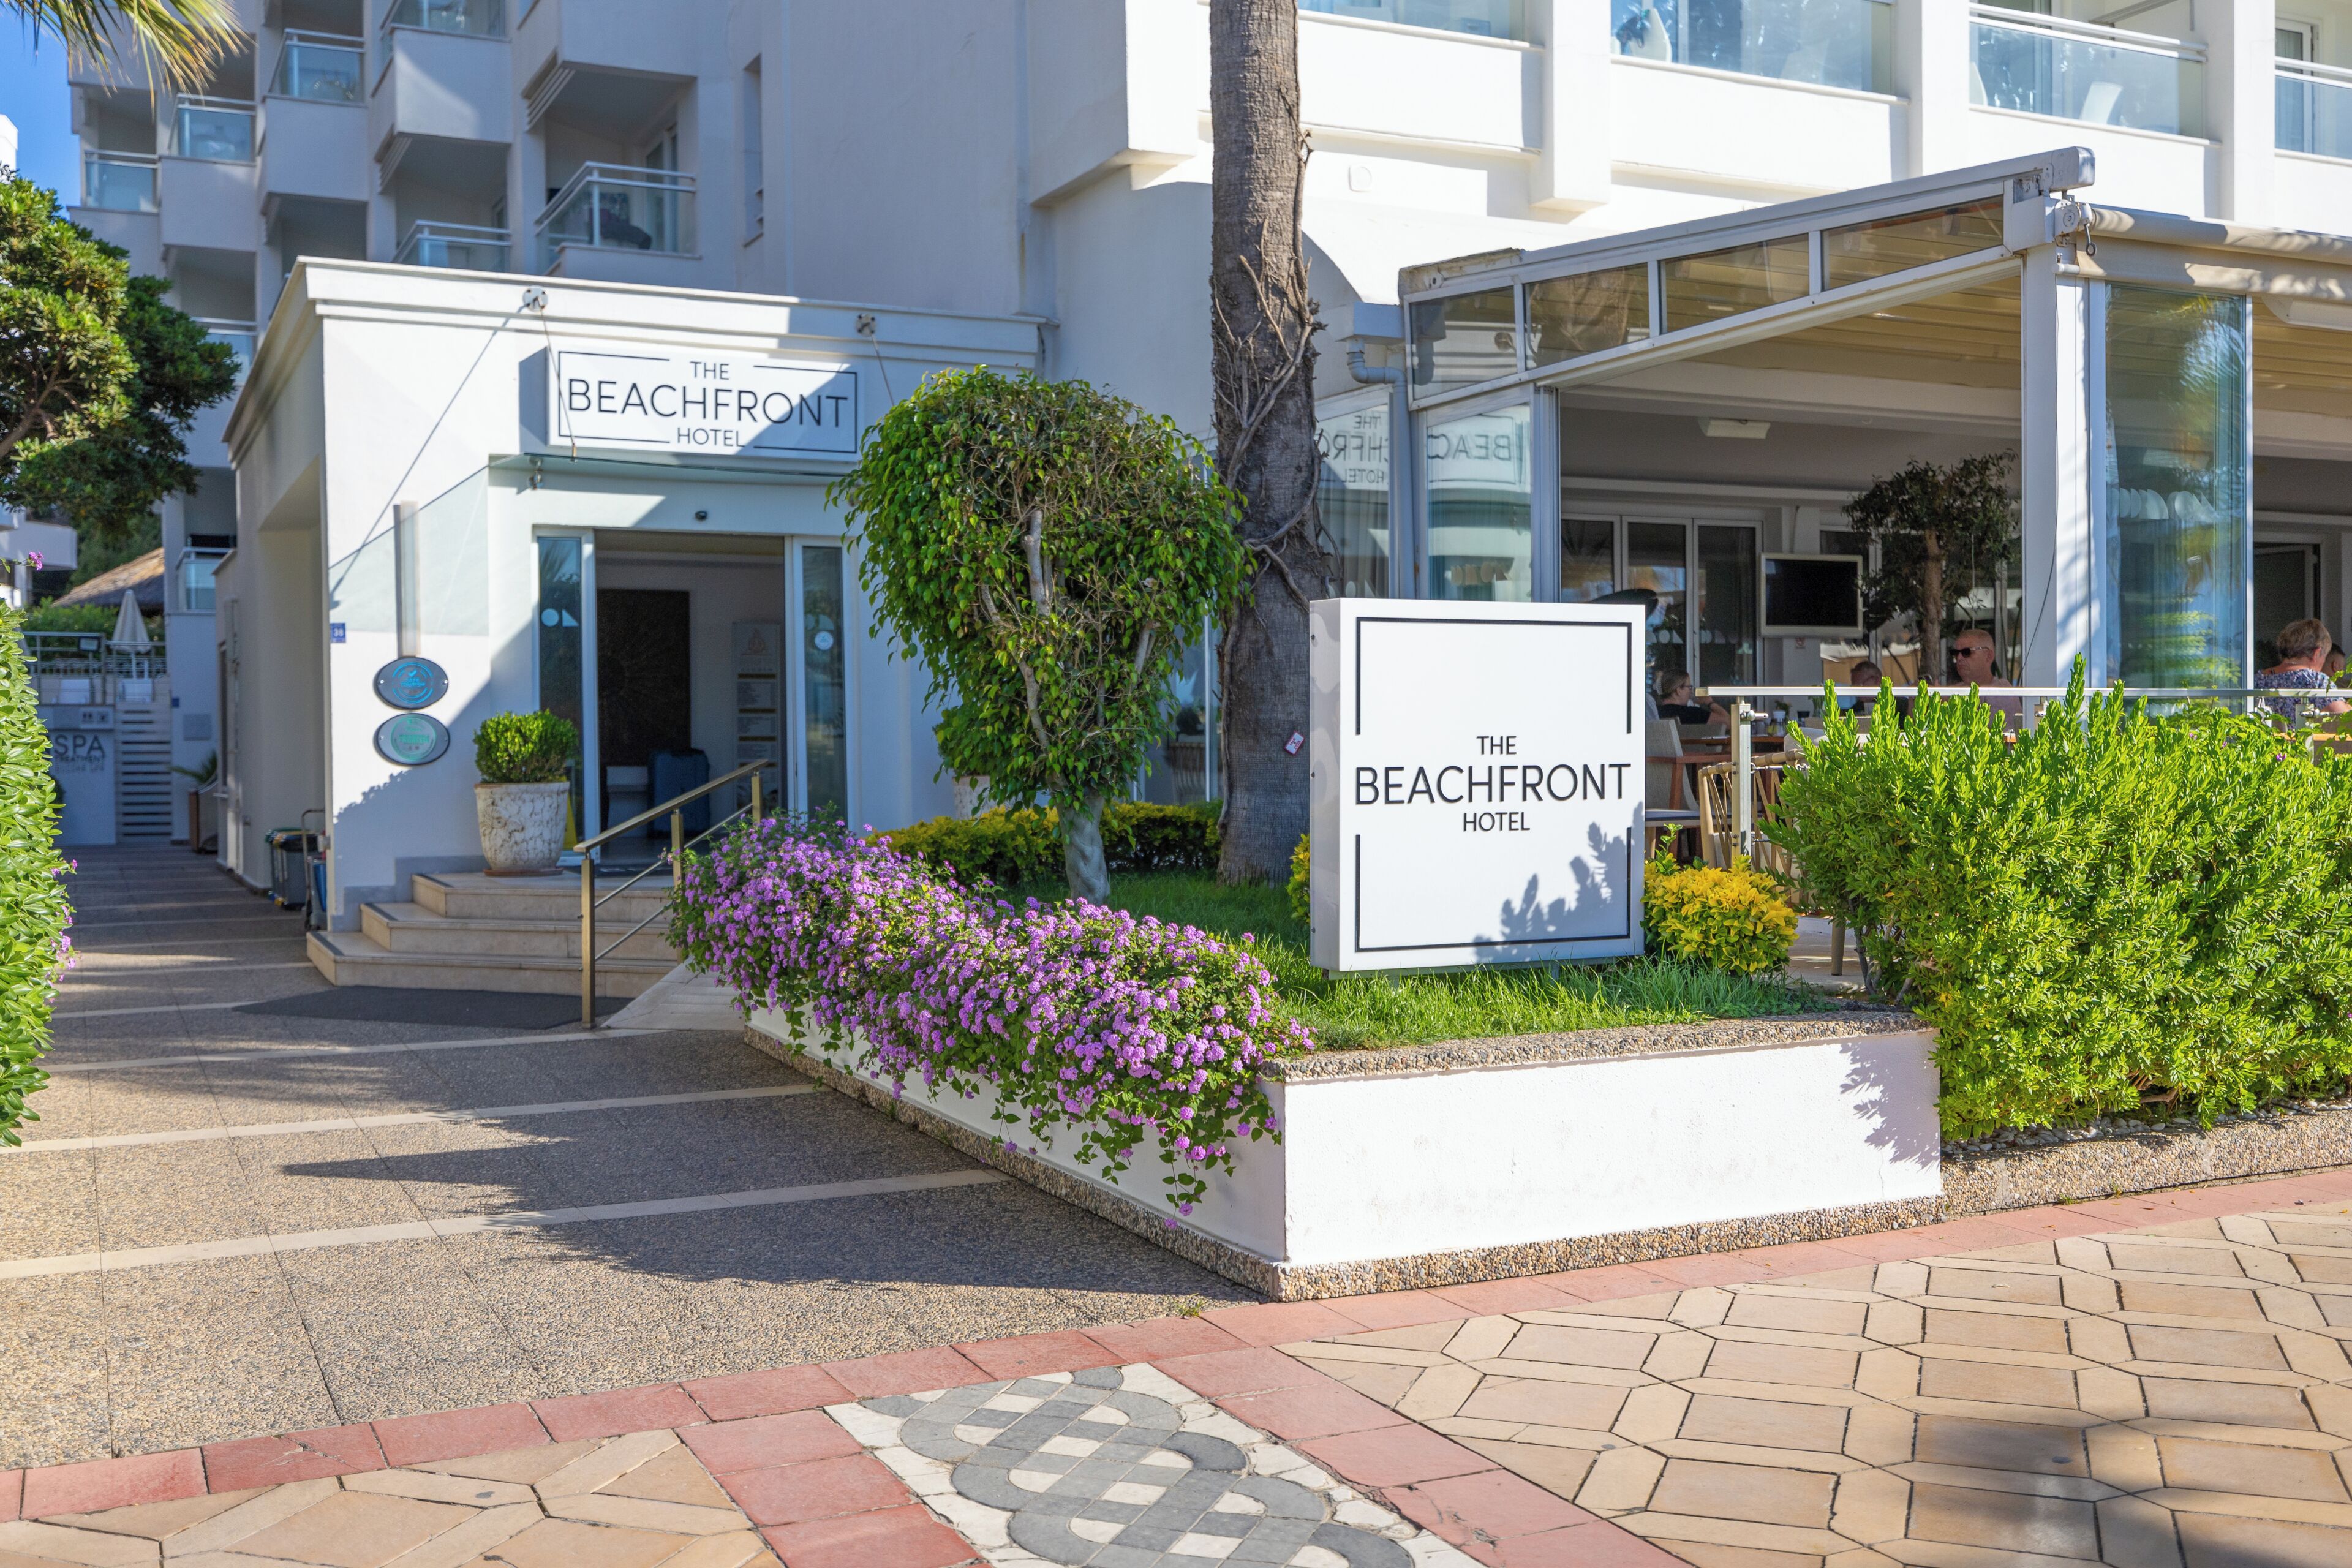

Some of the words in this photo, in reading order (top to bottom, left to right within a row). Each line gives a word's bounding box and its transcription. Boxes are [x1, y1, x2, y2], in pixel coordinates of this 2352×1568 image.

[690, 361, 729, 380] THE
[568, 378, 848, 428] BEACHFRONT
[677, 427, 745, 447] HOTEL
[55, 734, 105, 757] SPA
[1476, 736, 1517, 755] THE
[1355, 763, 1632, 805] BEACHFRONT
[1463, 812, 1531, 832] HOTEL
